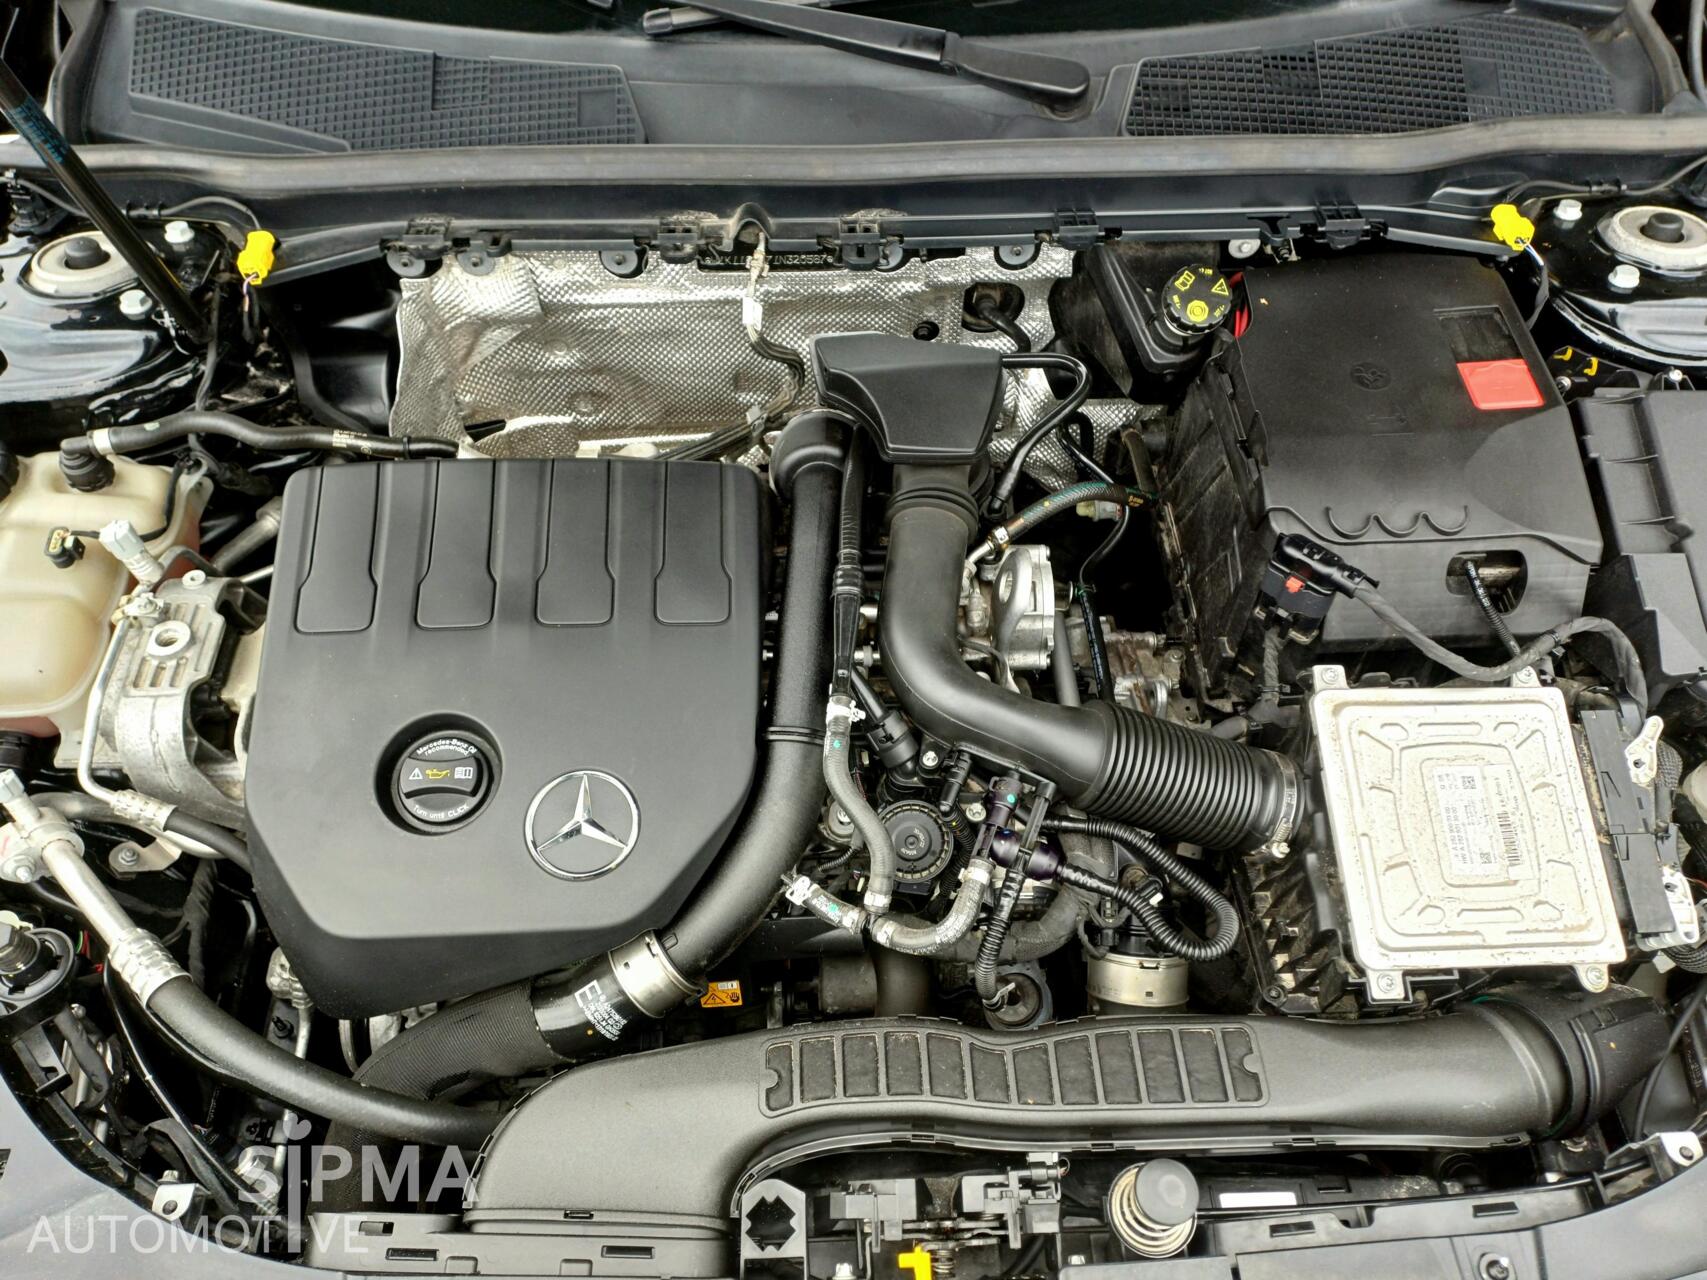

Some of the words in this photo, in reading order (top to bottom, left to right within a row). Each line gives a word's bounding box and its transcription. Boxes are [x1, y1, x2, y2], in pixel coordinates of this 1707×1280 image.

[416, 738, 468, 755] Mercedes-Benz
[424, 744, 470, 756] recommended
[413, 804, 427, 817] Turn
[429, 811, 445, 819] until
[447, 803, 470, 818] CLICK
